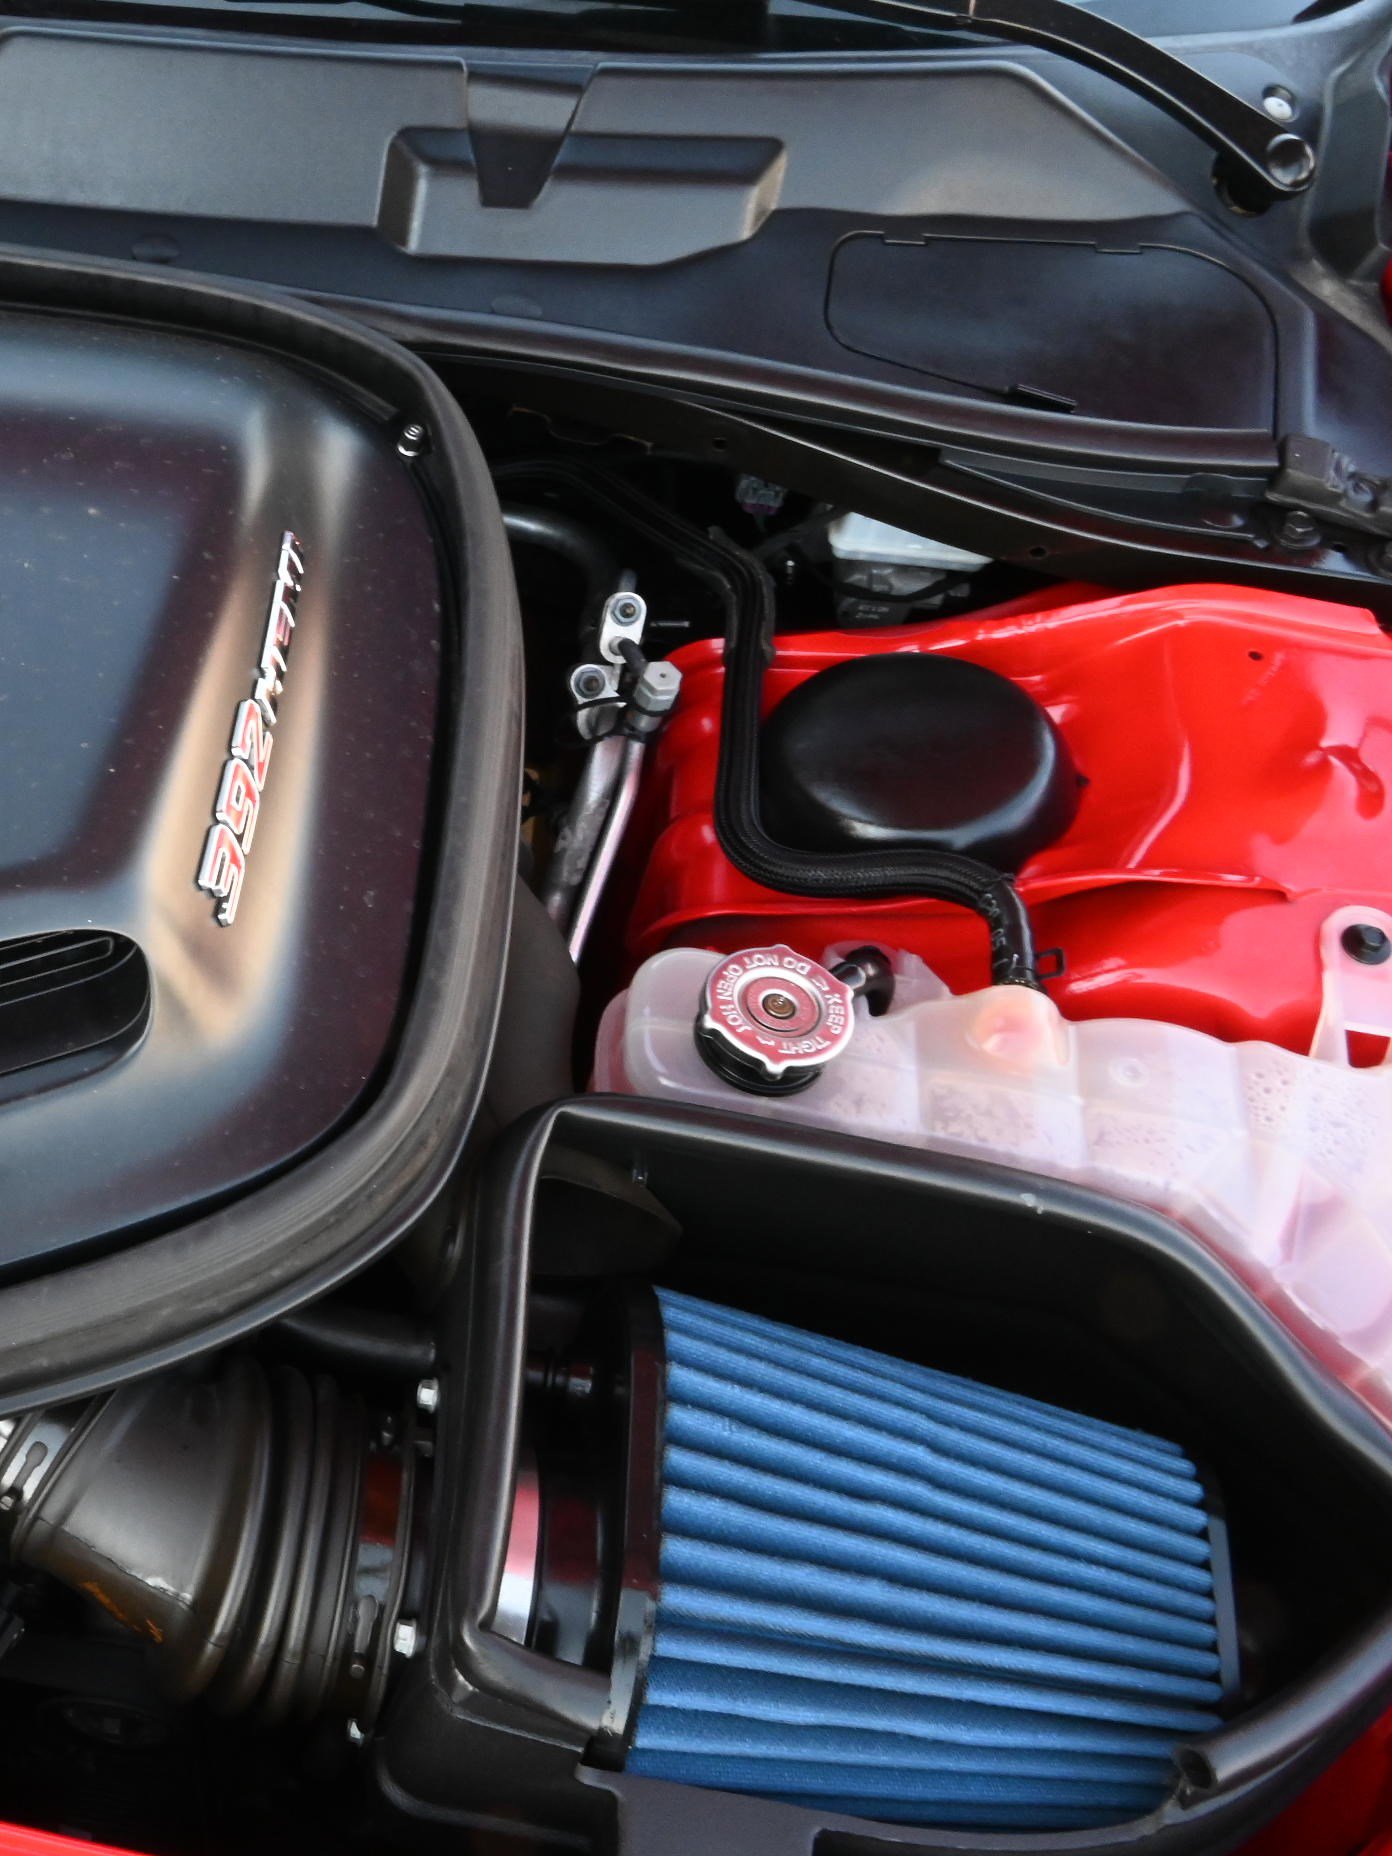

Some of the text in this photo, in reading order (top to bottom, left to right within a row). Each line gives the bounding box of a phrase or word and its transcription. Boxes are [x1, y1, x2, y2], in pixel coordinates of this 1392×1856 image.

[198, 698, 274, 927] 392
[715, 953, 811, 1033] DO NOT OPEN HOT
[777, 993, 846, 1055] KEEP TIGHT
